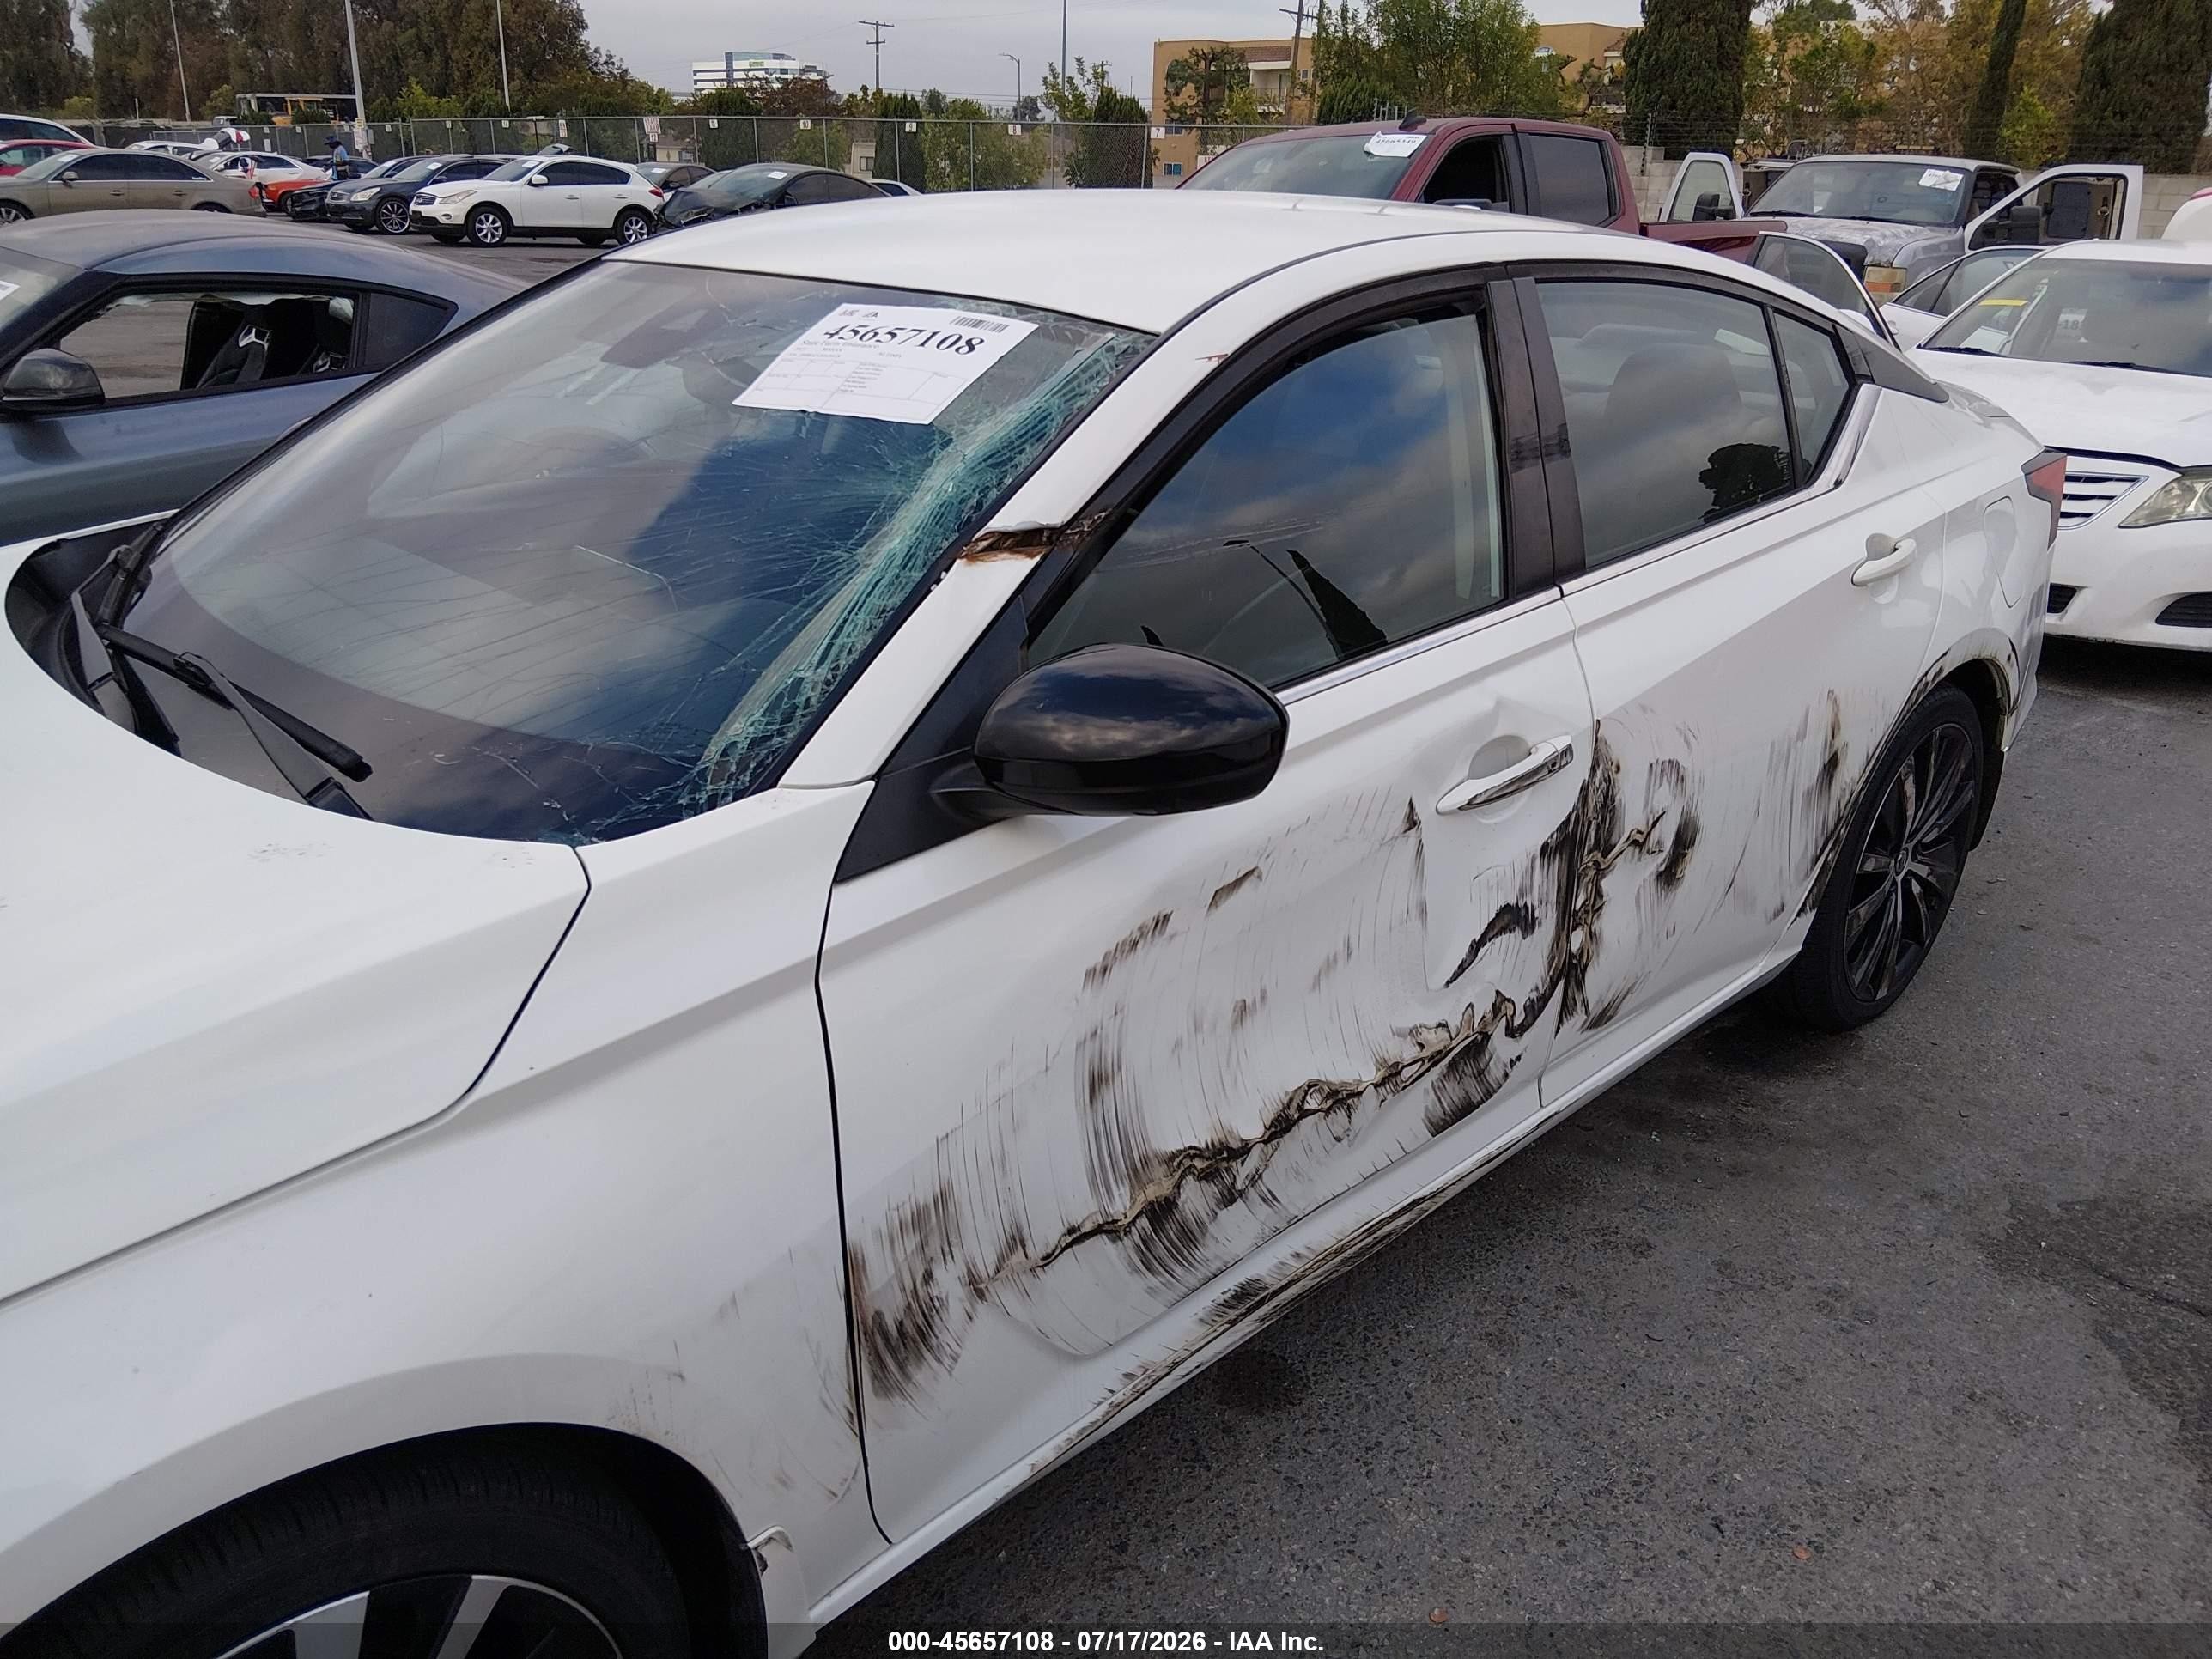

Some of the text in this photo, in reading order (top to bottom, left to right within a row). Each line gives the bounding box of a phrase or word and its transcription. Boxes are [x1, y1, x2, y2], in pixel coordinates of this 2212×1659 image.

[802, 120, 809, 129] 10
[1155, 128, 1161, 138] 7
[824, 324, 985, 355] 45657108
